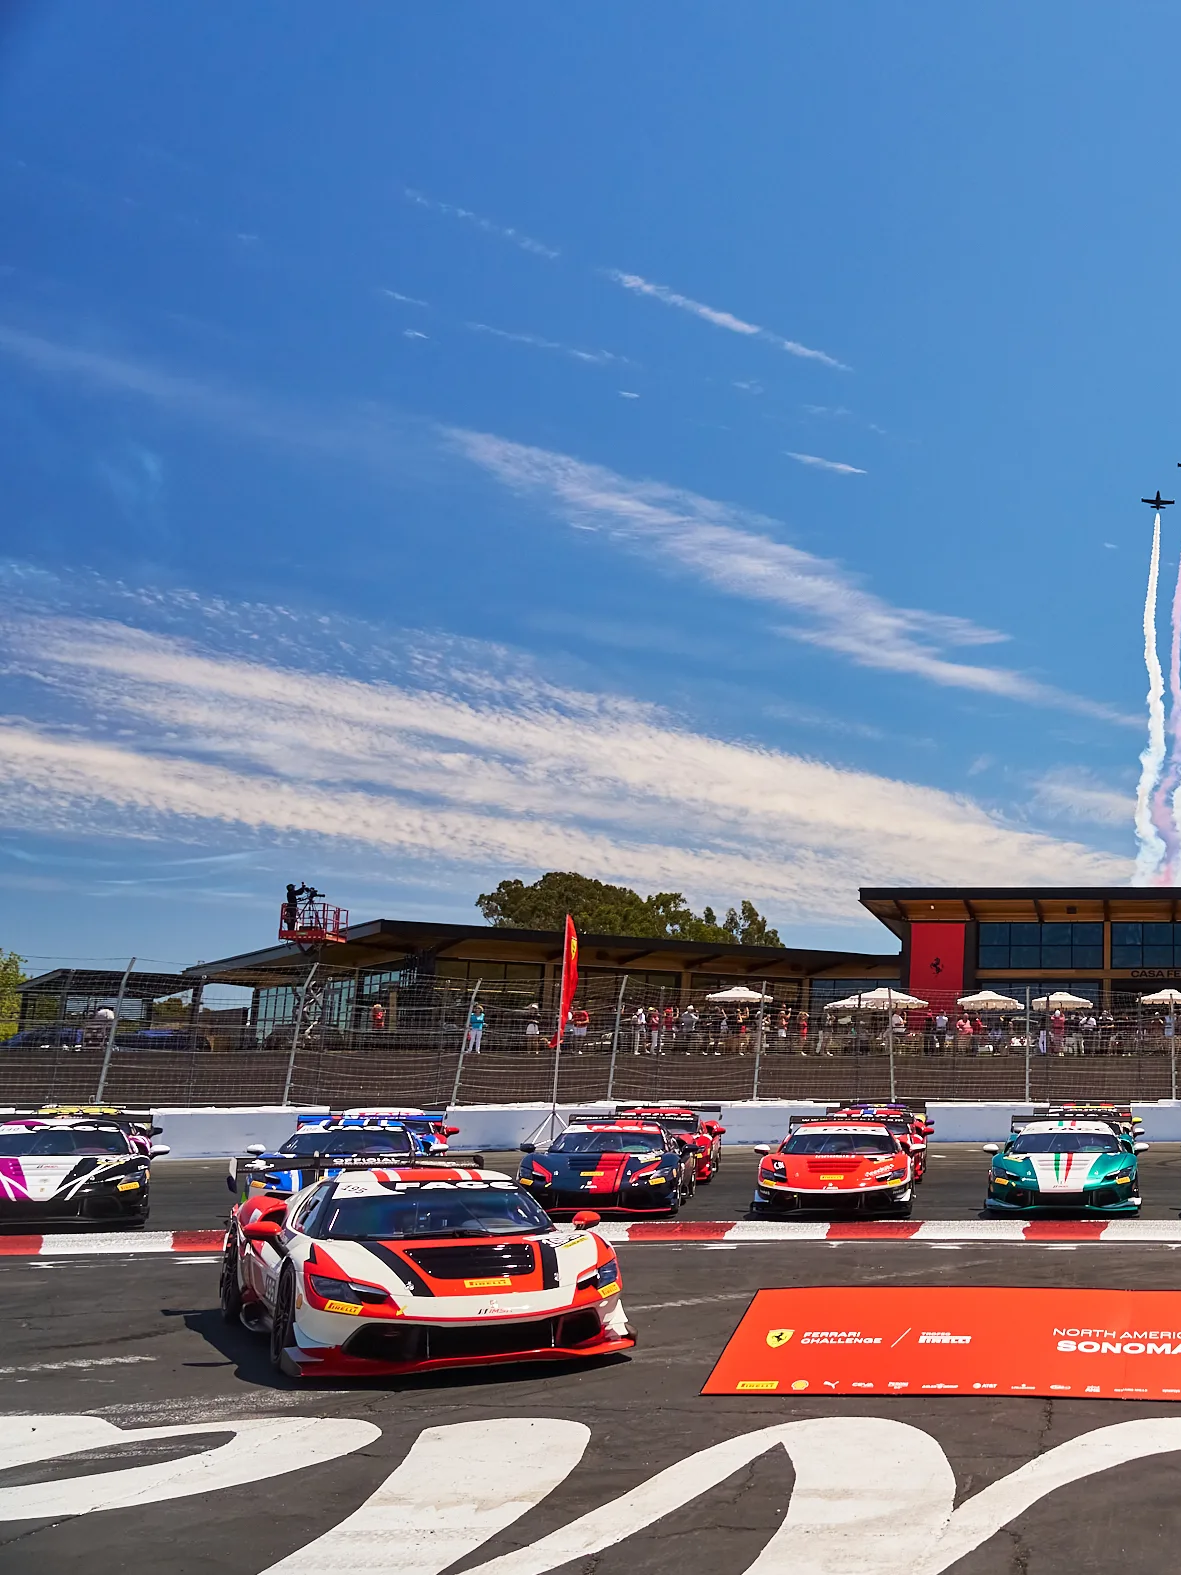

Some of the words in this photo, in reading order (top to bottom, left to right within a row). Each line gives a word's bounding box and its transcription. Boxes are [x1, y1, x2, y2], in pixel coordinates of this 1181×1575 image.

[1130, 970, 1165, 978] CASA
[341, 1184, 368, 1195] 195
[328, 1303, 359, 1314] PIRELLI
[1053, 1328, 1116, 1338] NORTH
